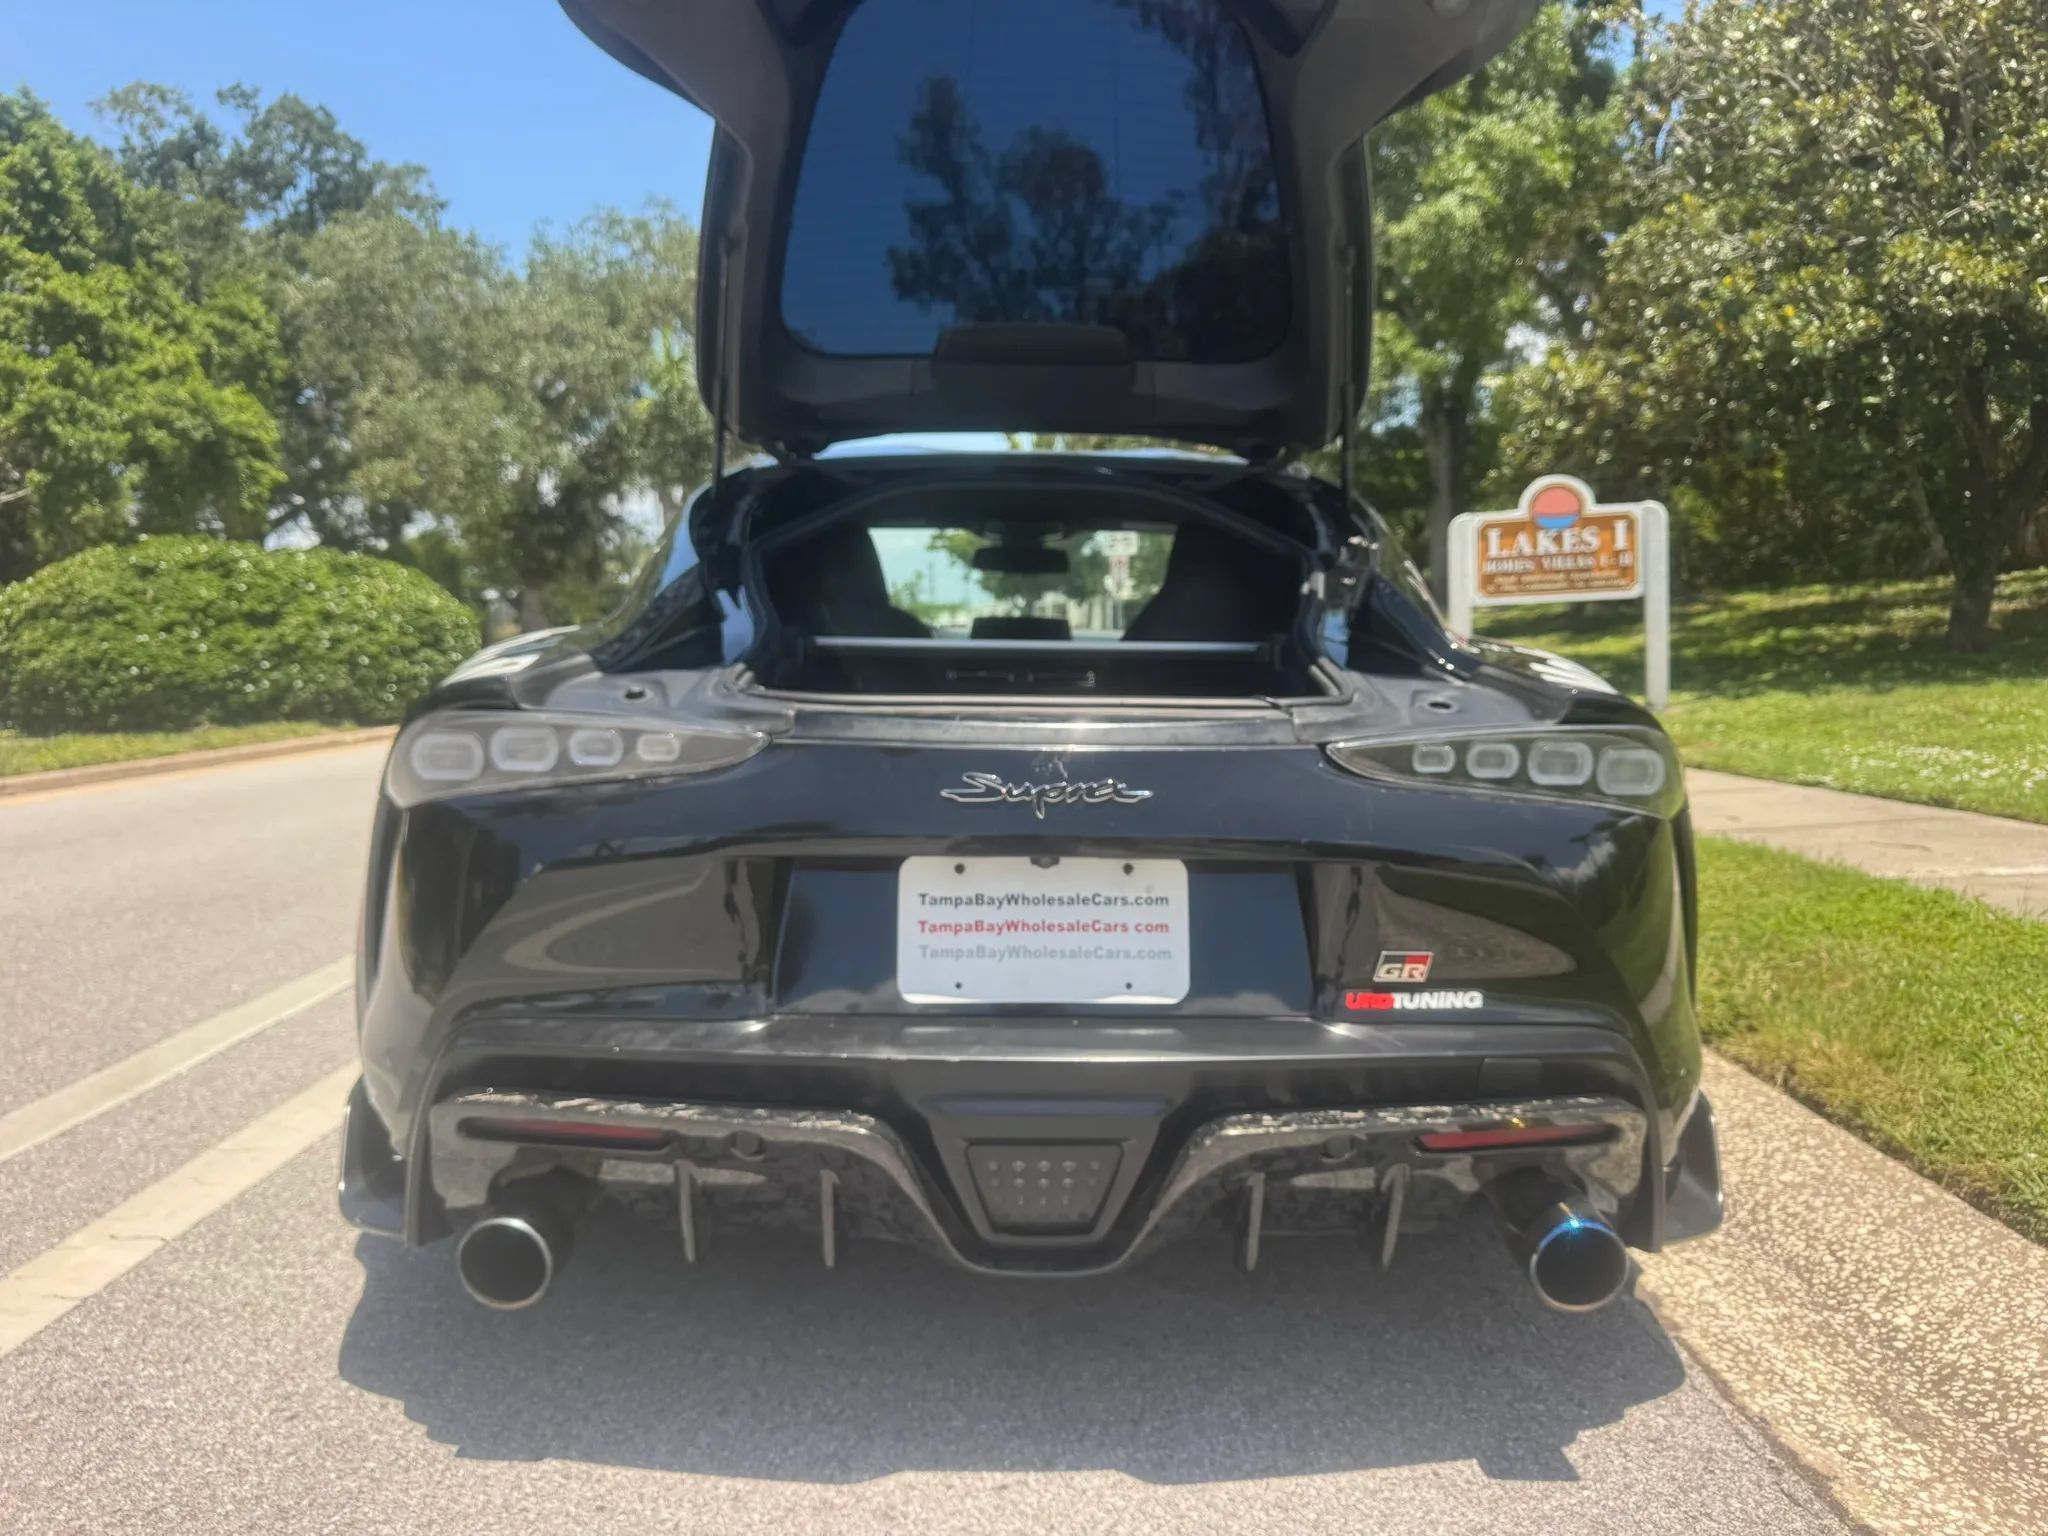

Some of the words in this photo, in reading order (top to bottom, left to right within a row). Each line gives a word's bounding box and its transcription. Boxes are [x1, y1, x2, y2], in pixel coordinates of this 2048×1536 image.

[1487, 526, 1601, 557] LAKES
[940, 771, 1153, 819] Supra
[918, 893, 1169, 909] TampaBayWholesaleCars.com
[918, 920, 1169, 935] TampaBayWholesaleCarscom
[920, 946, 1172, 962] TampaBayWholesaleCars.com
[1376, 963, 1426, 979] GR
